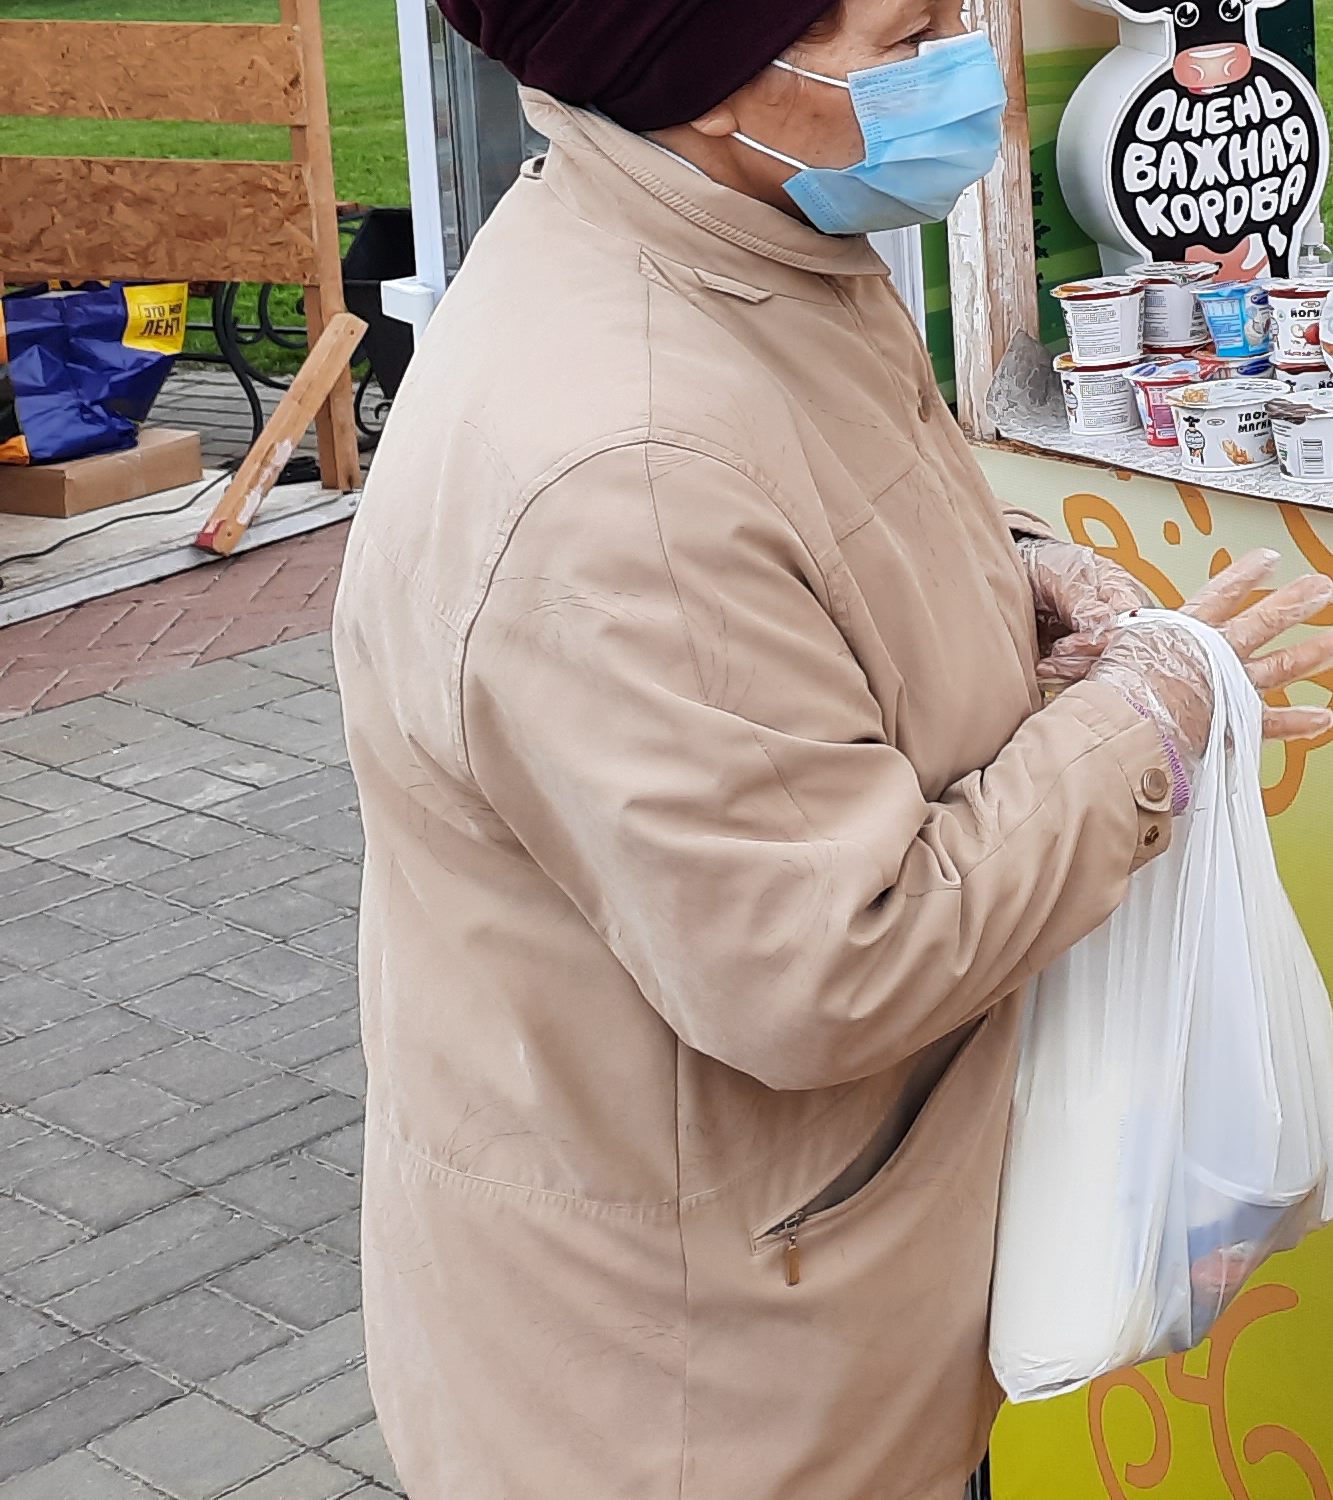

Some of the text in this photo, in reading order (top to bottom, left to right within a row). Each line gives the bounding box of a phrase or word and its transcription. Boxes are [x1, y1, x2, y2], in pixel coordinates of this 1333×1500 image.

[1135, 75, 1292, 142] ОЧЕНЬ
[1122, 115, 1309, 193] ВАЖНАЯ
[1135, 164, 1307, 238] КОРОВА
[1290, 308, 1322, 318] ЙОГУ
[1237, 411, 1269, 424] ТВОР
